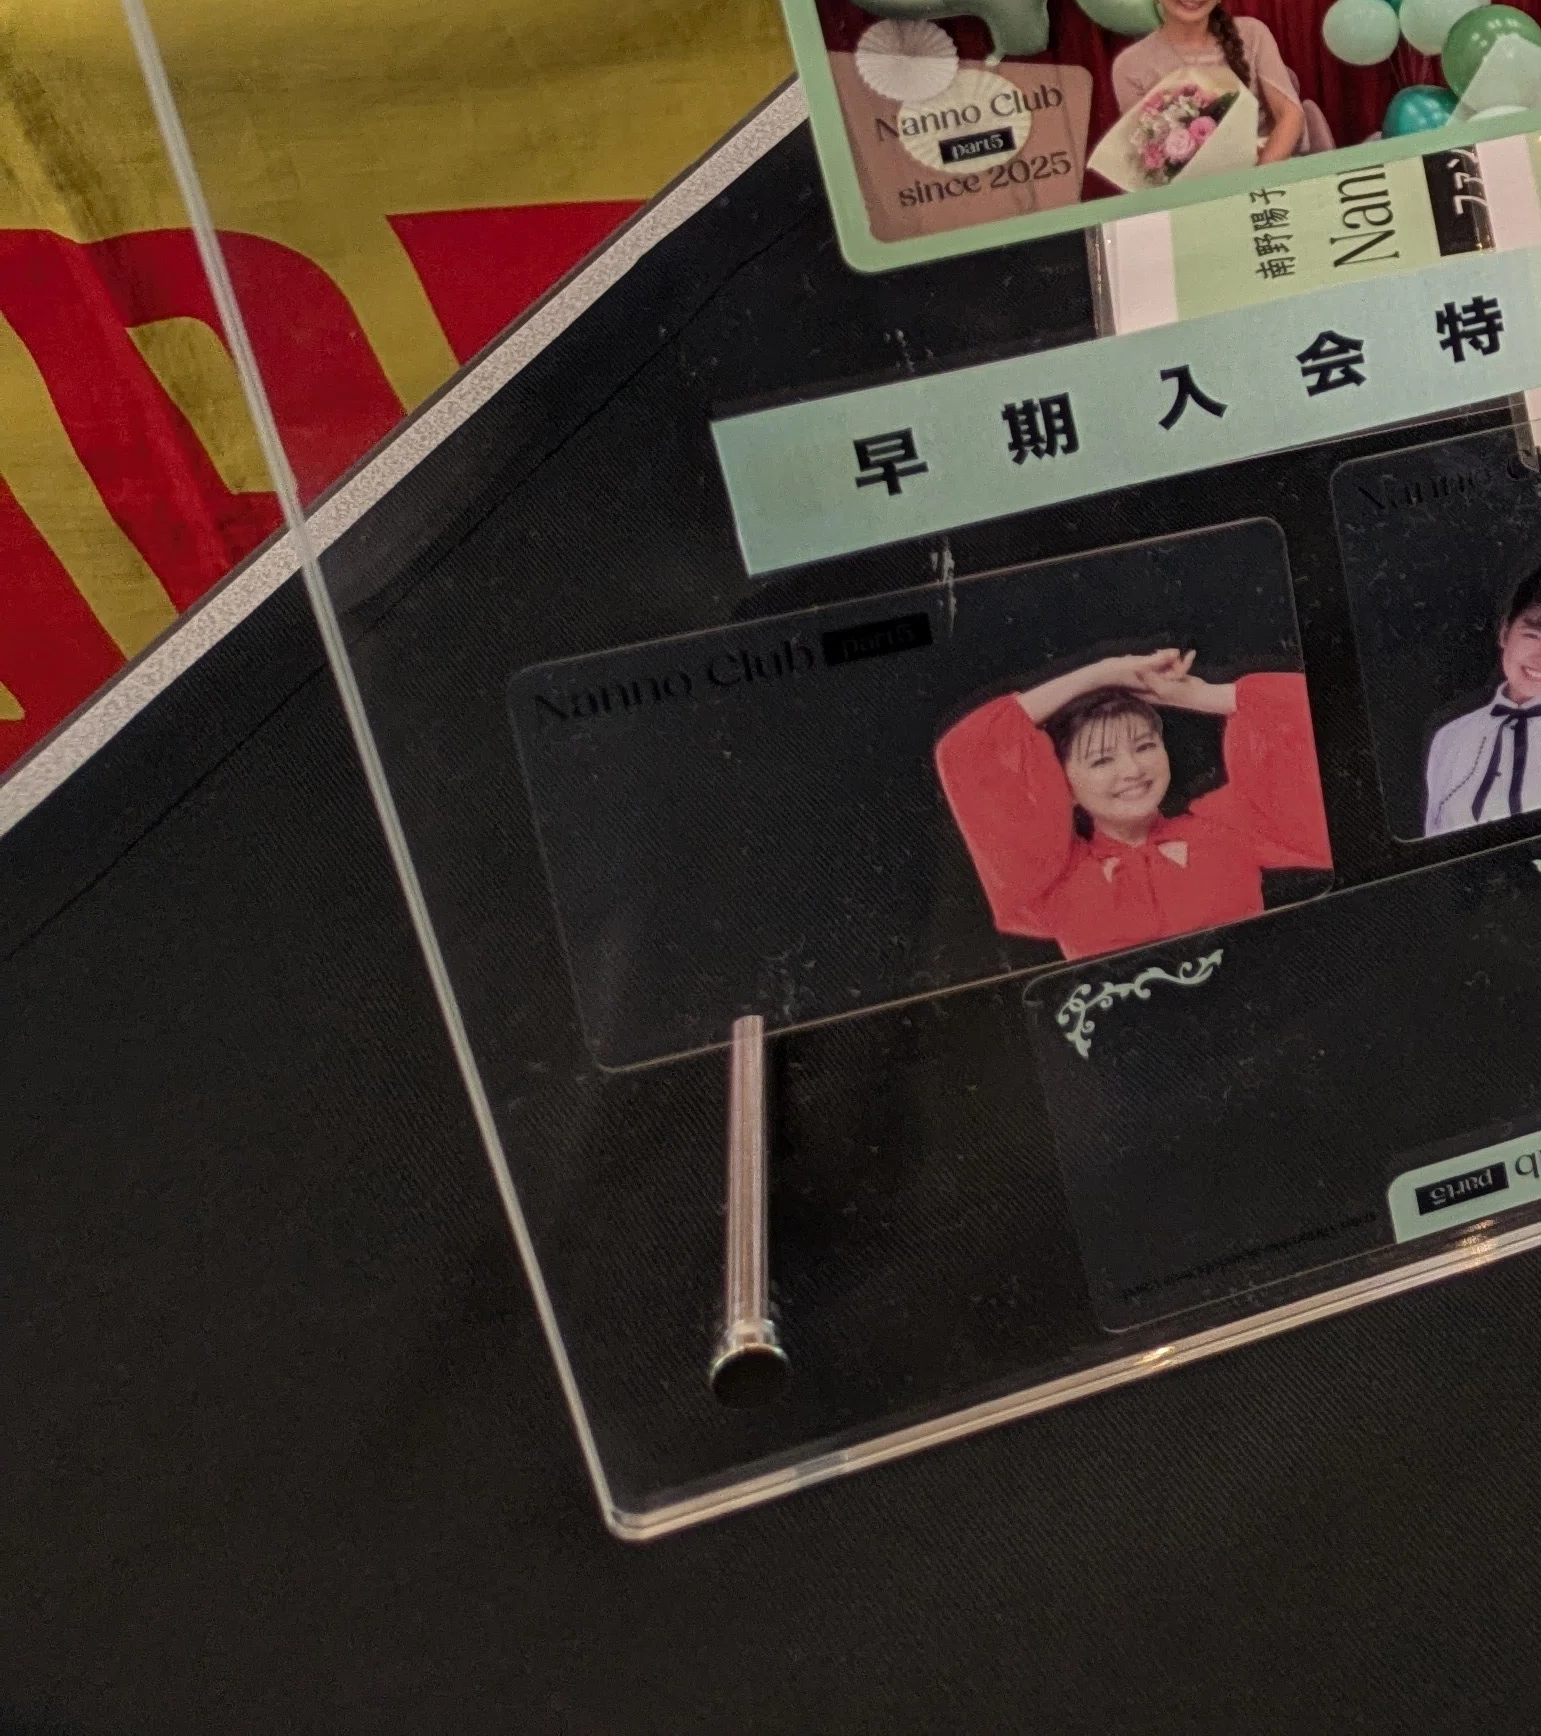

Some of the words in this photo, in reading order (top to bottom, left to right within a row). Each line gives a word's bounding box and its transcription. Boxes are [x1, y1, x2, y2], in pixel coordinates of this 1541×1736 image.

[874, 103, 982, 142] Nanno
[990, 84, 1063, 118] Club
[951, 133, 1005, 161] part5
[899, 173, 983, 208] since
[987, 150, 1073, 190] 2025
[1250, 186, 1297, 282] 南野陽子
[1331, 163, 1401, 268] Nan
[534, 671, 694, 722] Nanno
[707, 638, 815, 688] Club
